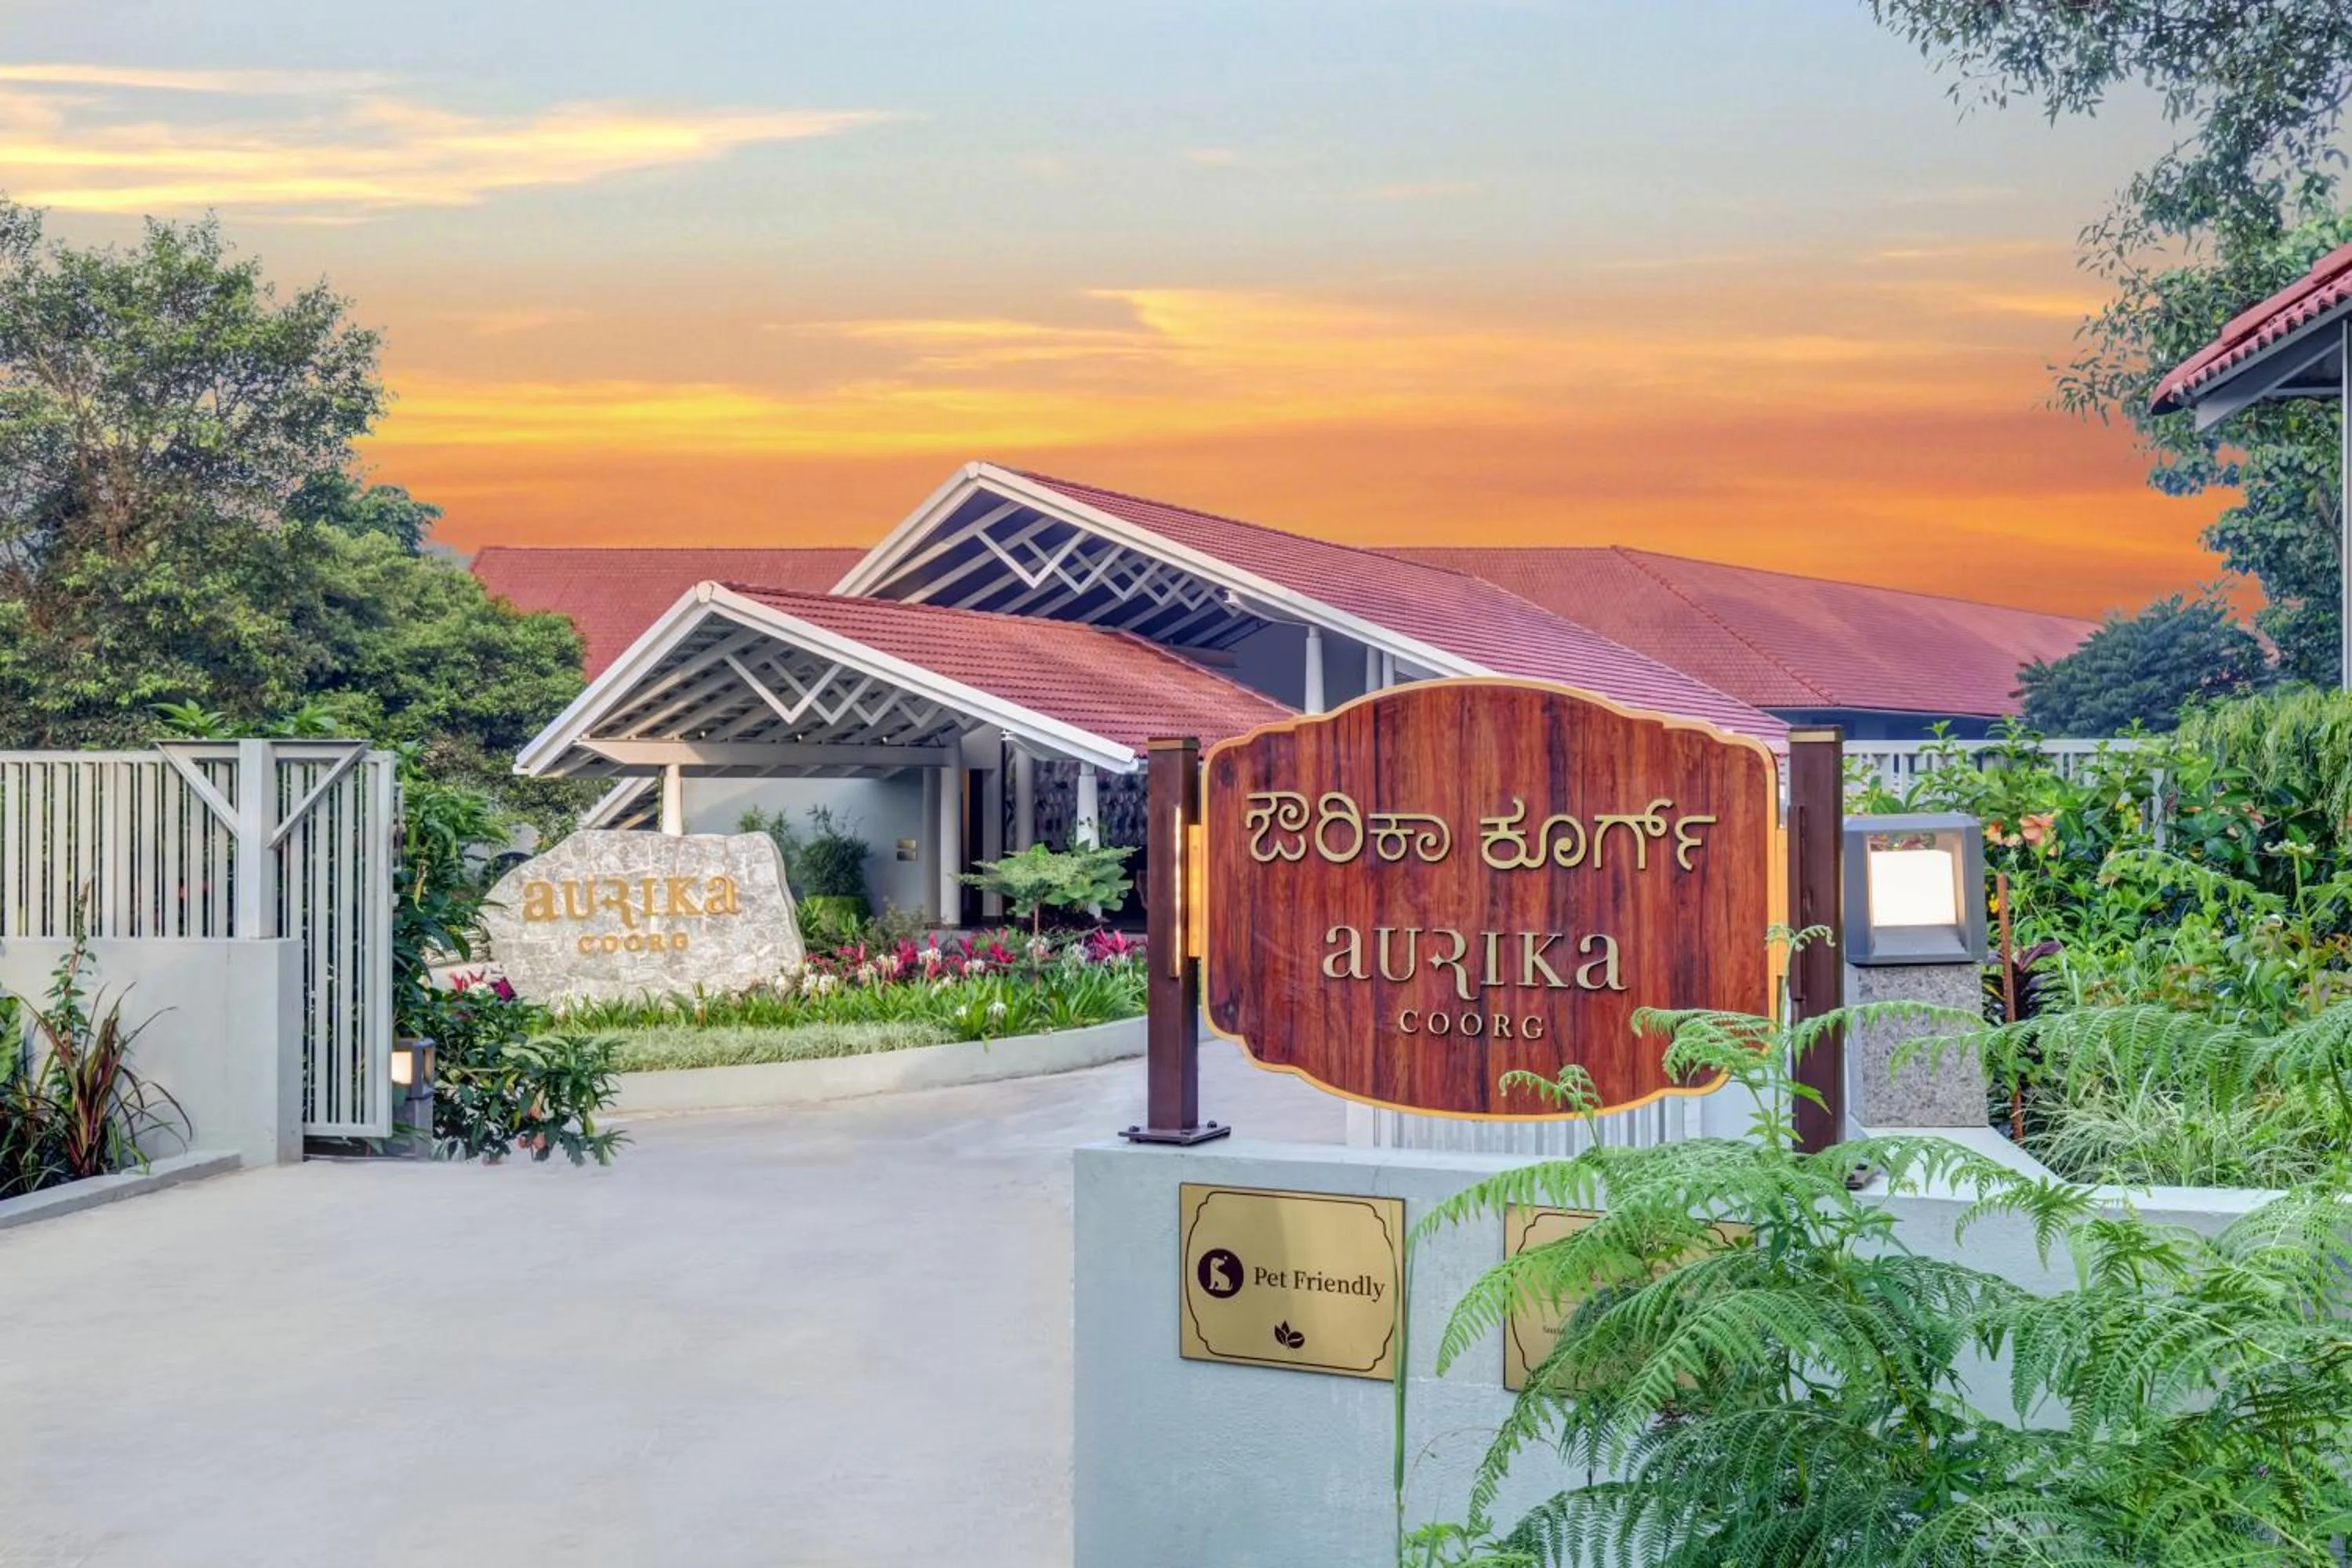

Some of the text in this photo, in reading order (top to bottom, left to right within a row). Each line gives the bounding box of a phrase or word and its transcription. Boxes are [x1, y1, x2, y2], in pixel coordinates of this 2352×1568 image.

[576, 931, 690, 955] COORG
[1399, 1009, 1544, 1040] COORG
[1254, 1266, 1386, 1303] Pet Friendly
